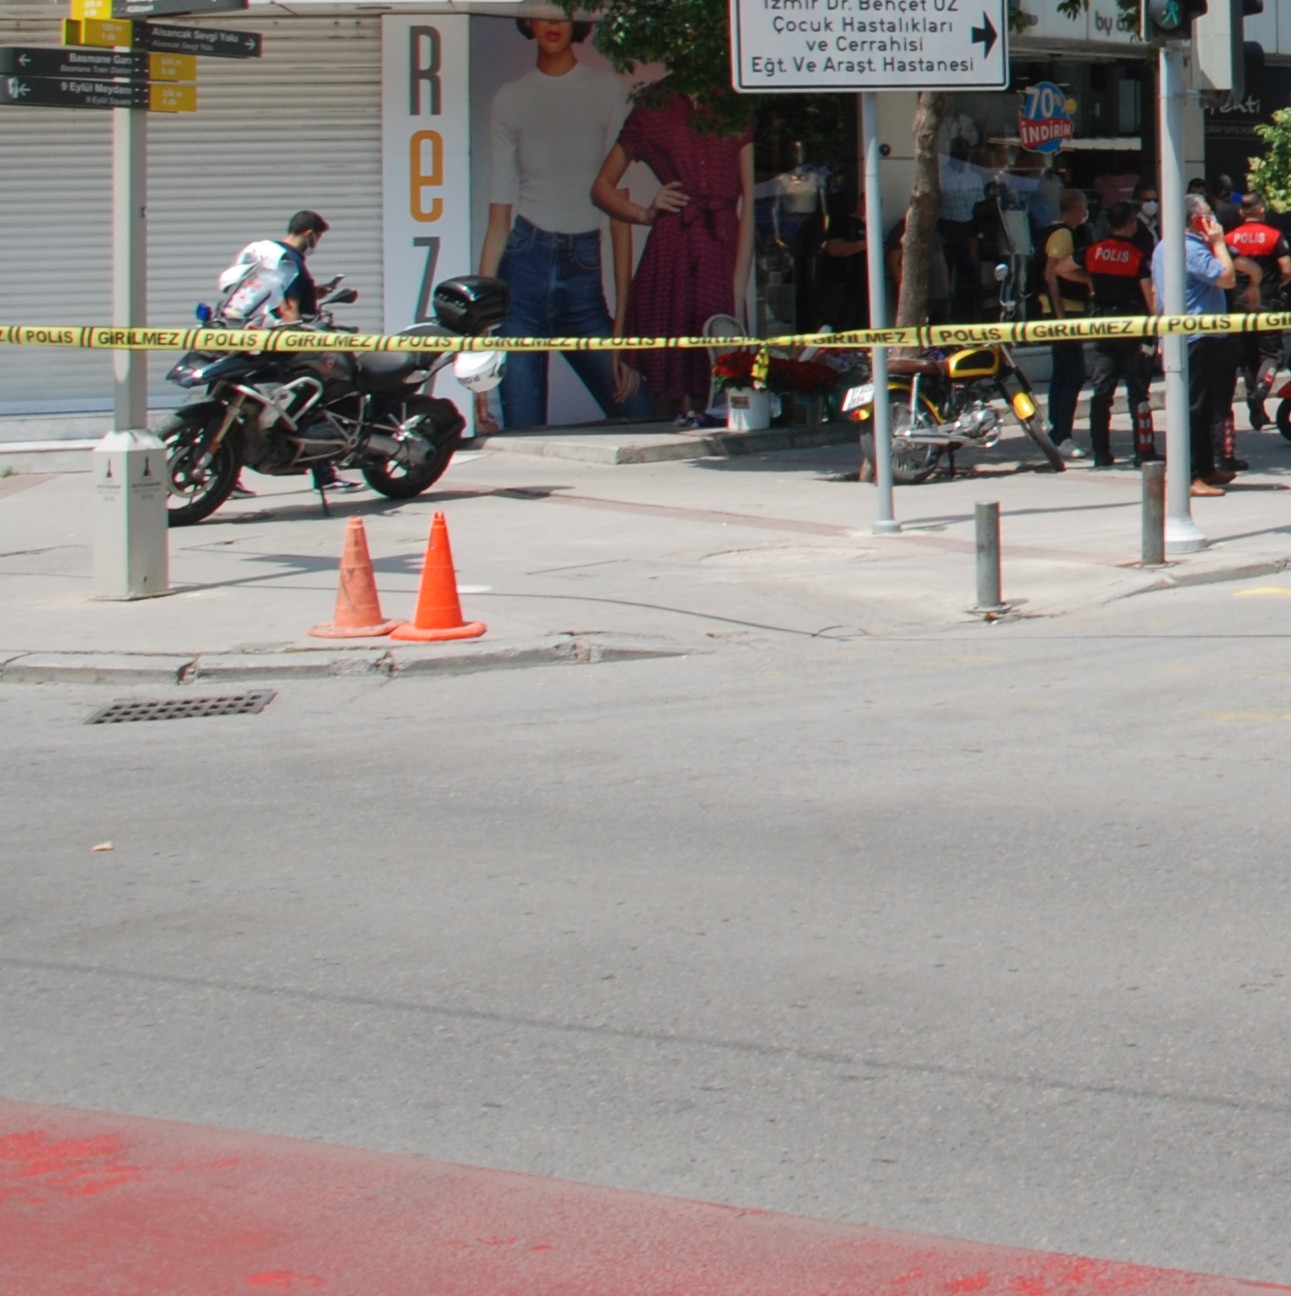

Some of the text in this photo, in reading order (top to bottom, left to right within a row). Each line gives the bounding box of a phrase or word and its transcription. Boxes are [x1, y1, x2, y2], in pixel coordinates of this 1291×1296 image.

[772, 15, 954, 35] Çocuk Hastalıkları
[1095, 11, 1113, 37] by
[152, 27, 192, 39] Alsancak
[193, 30, 218, 43] Sevgi
[806, 36, 924, 53] ve Cerrahisi
[69, 52, 112, 64] Basmane
[751, 56, 975, 77] Eğt. Ve Araşt. Hastanesi
[69, 82, 93, 94] Eylül
[1021, 122, 1073, 146] İNDİRİM
[26, 329, 74, 344] POLİS
[97, 331, 180, 346] GİRİLMEZ
[204, 332, 258, 348] POLİS
[939, 326, 1001, 342] POLİS
[1032, 319, 1135, 338] GİRİLMEZ
[1167, 315, 1232, 332] POLİS
